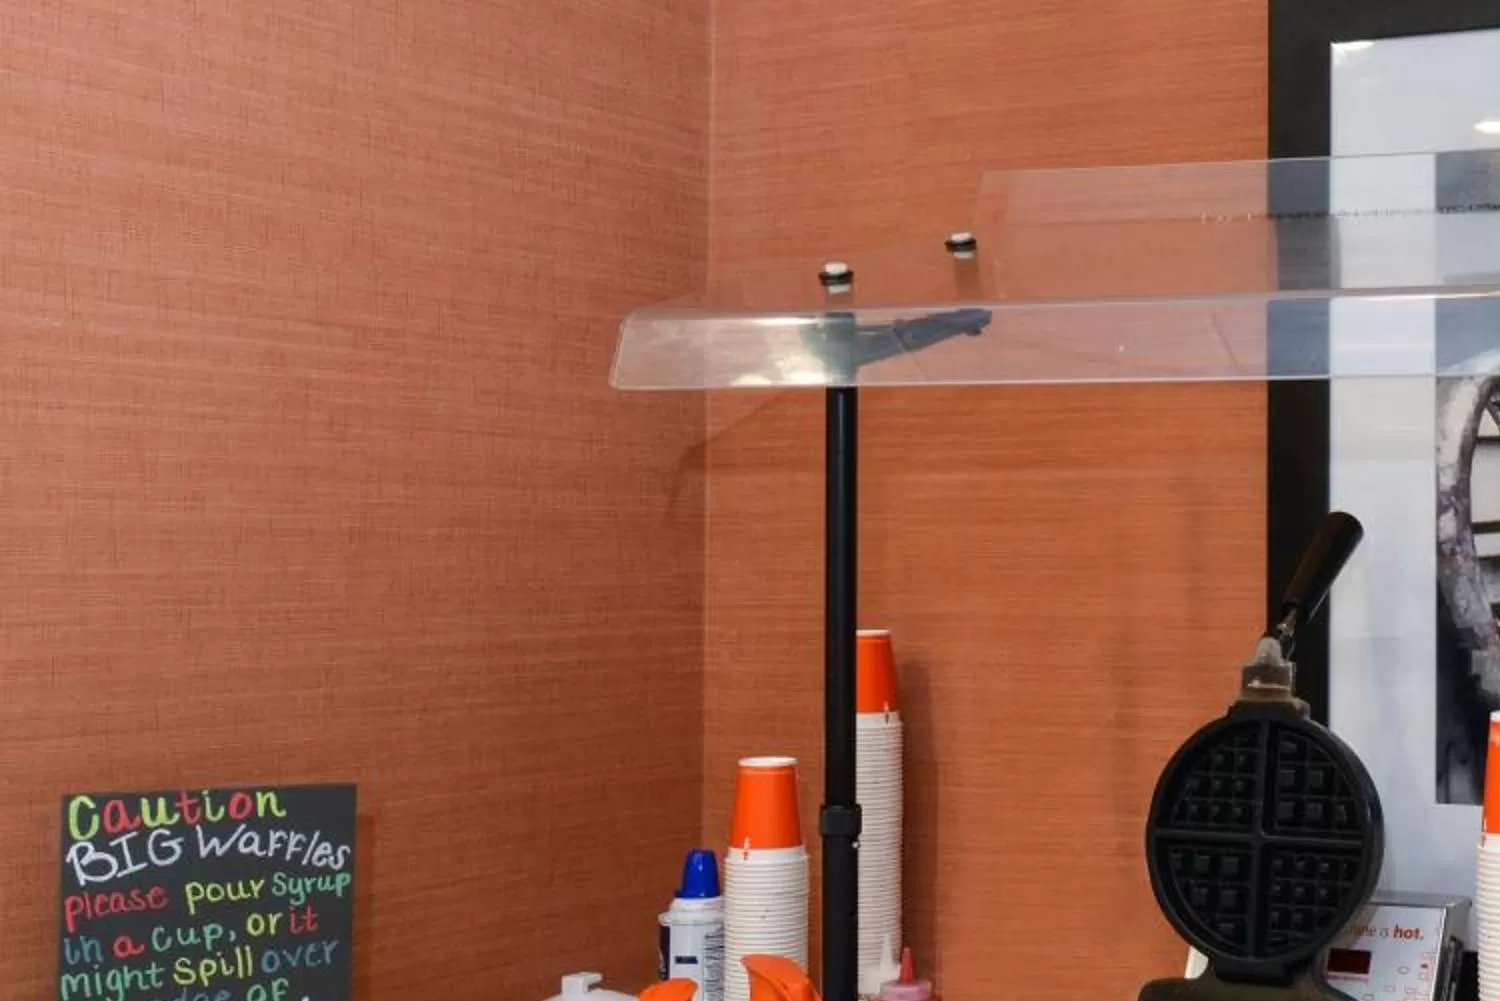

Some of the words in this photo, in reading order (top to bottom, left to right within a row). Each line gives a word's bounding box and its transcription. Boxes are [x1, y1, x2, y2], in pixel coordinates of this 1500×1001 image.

[68, 789, 287, 841] Caution
[65, 828, 185, 886] BIG
[185, 879, 265, 915] pour
[64, 937, 104, 965] in
[113, 935, 145, 957] a
[246, 912, 283, 935] or
[289, 904, 319, 934] it
[1392, 923, 1425, 941] hot.
[261, 938, 340, 974] over
